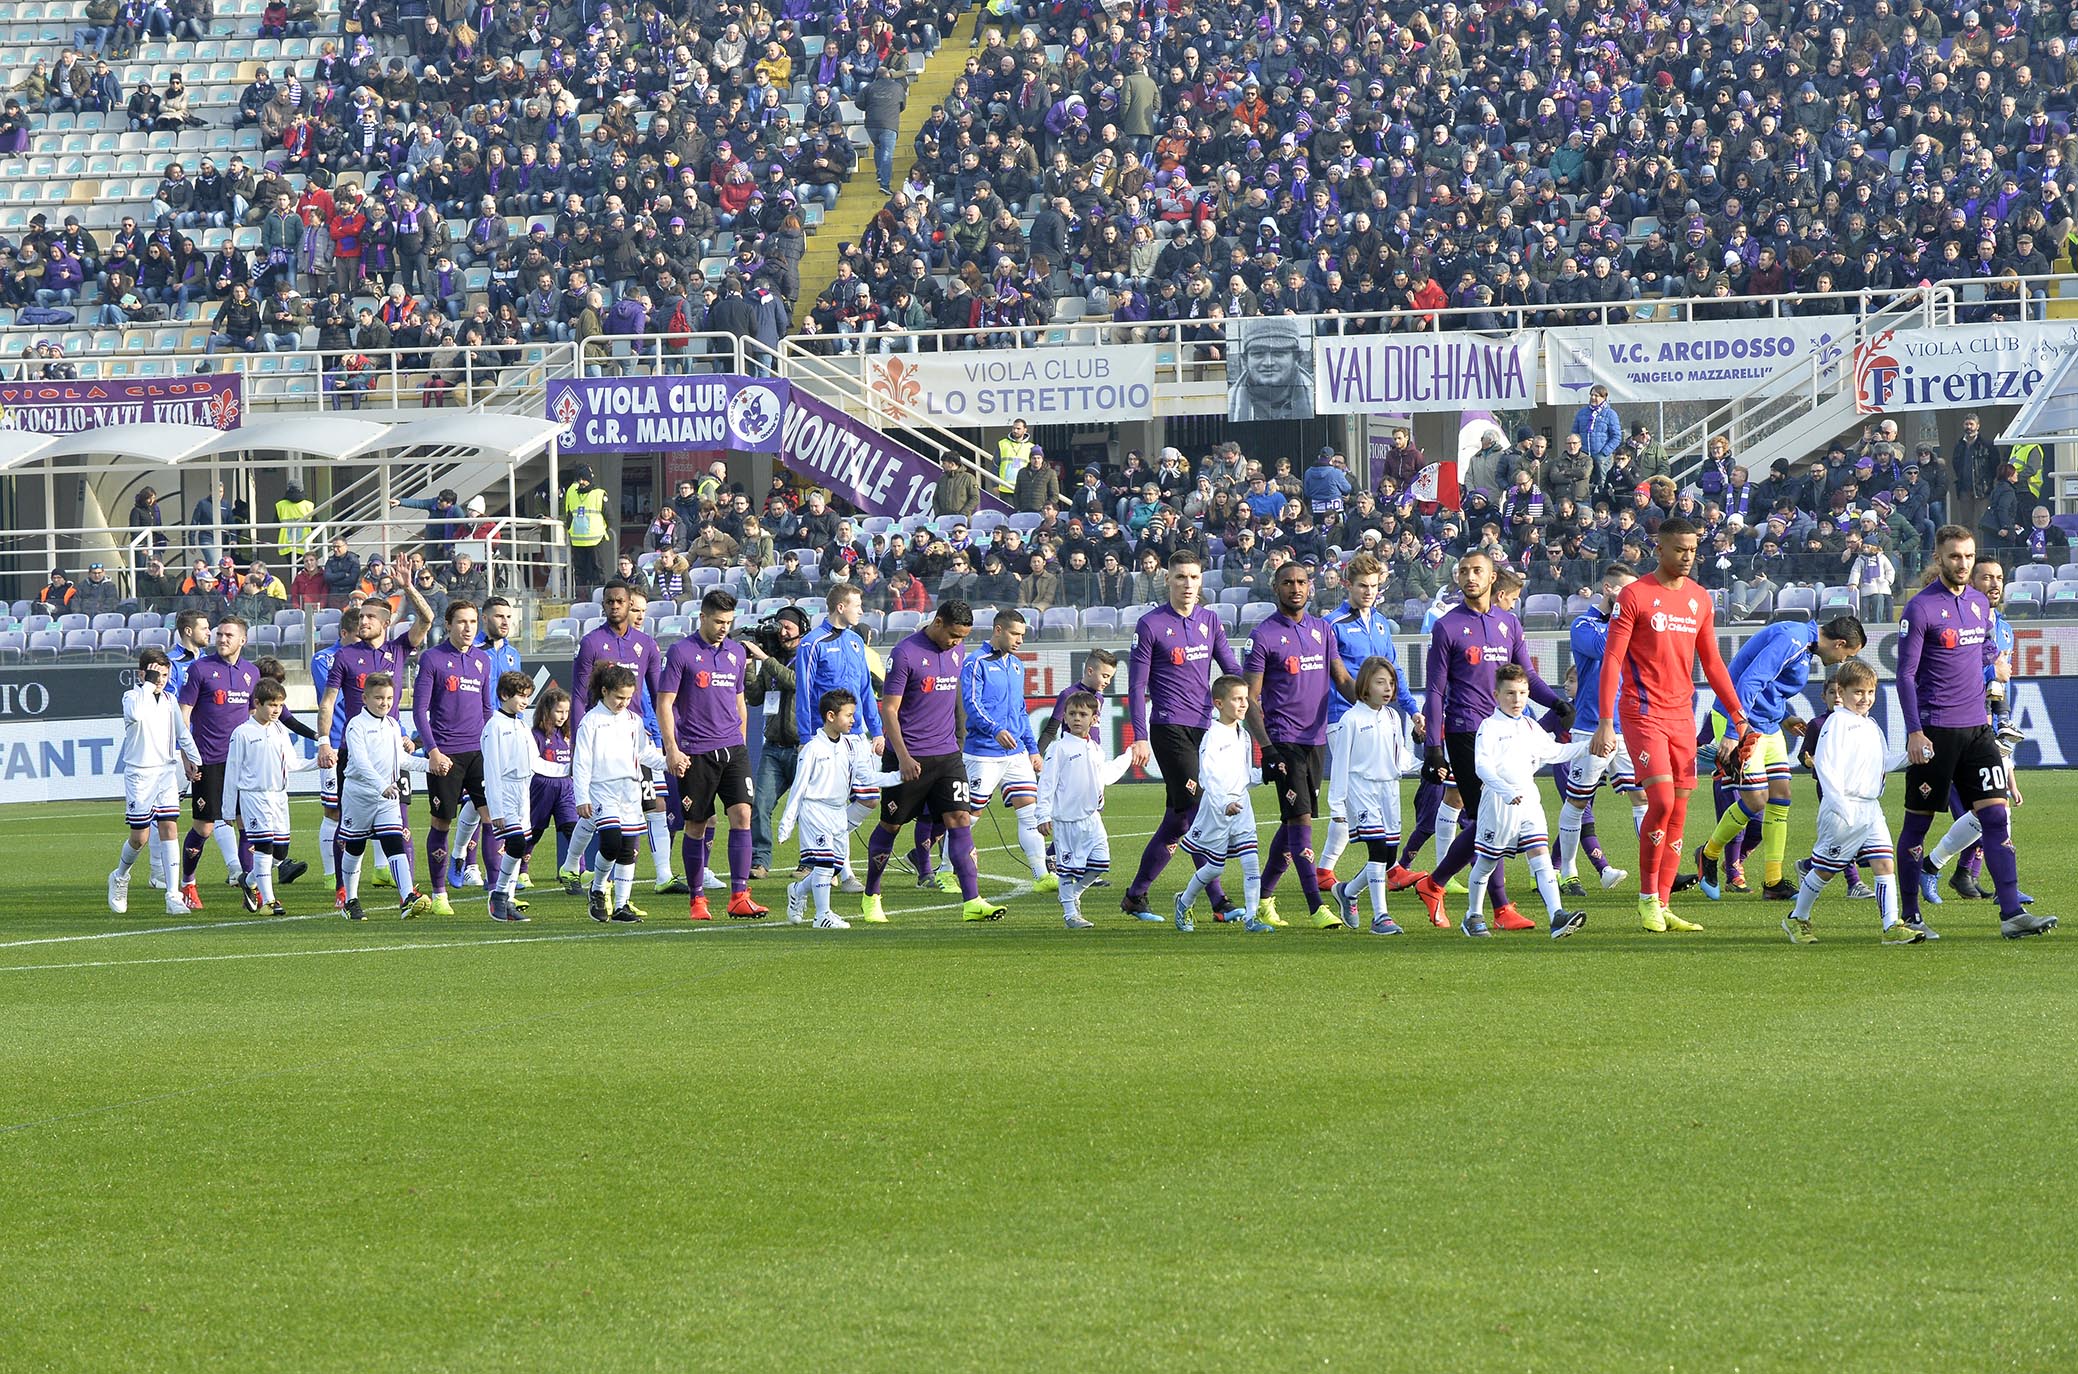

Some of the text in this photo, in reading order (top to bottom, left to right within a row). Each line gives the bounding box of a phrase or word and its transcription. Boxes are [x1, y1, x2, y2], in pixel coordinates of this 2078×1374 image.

[1608, 336, 1796, 363] V.C. ARCIDOSSO
[1905, 337, 2020, 357] VIOLA CLUB
[964, 358, 1110, 383] VIOLA CLUB
[1325, 343, 1528, 403] VALDICHIANA
[3, 382, 213, 402] VIOLA CLUB
[1868, 365, 2045, 406] Firenze
[586, 383, 727, 415] VIOLA CLUB
[927, 383, 1150, 415] LO STRETTOIO
[153, 400, 213, 426] VIOLA
[586, 415, 727, 445] C.R. MAIANO
[783, 401, 937, 522] MONTALE 19
[1667, 622, 1697, 634] Children
[1668, 614, 1697, 625] Save the
[1958, 628, 1975, 637] Save
[711, 672, 727, 680] Save
[935, 683, 957, 691] Childre
[744, 776, 754, 797] 9
[1979, 765, 2005, 792] 20
[952, 780, 970, 803] 29
